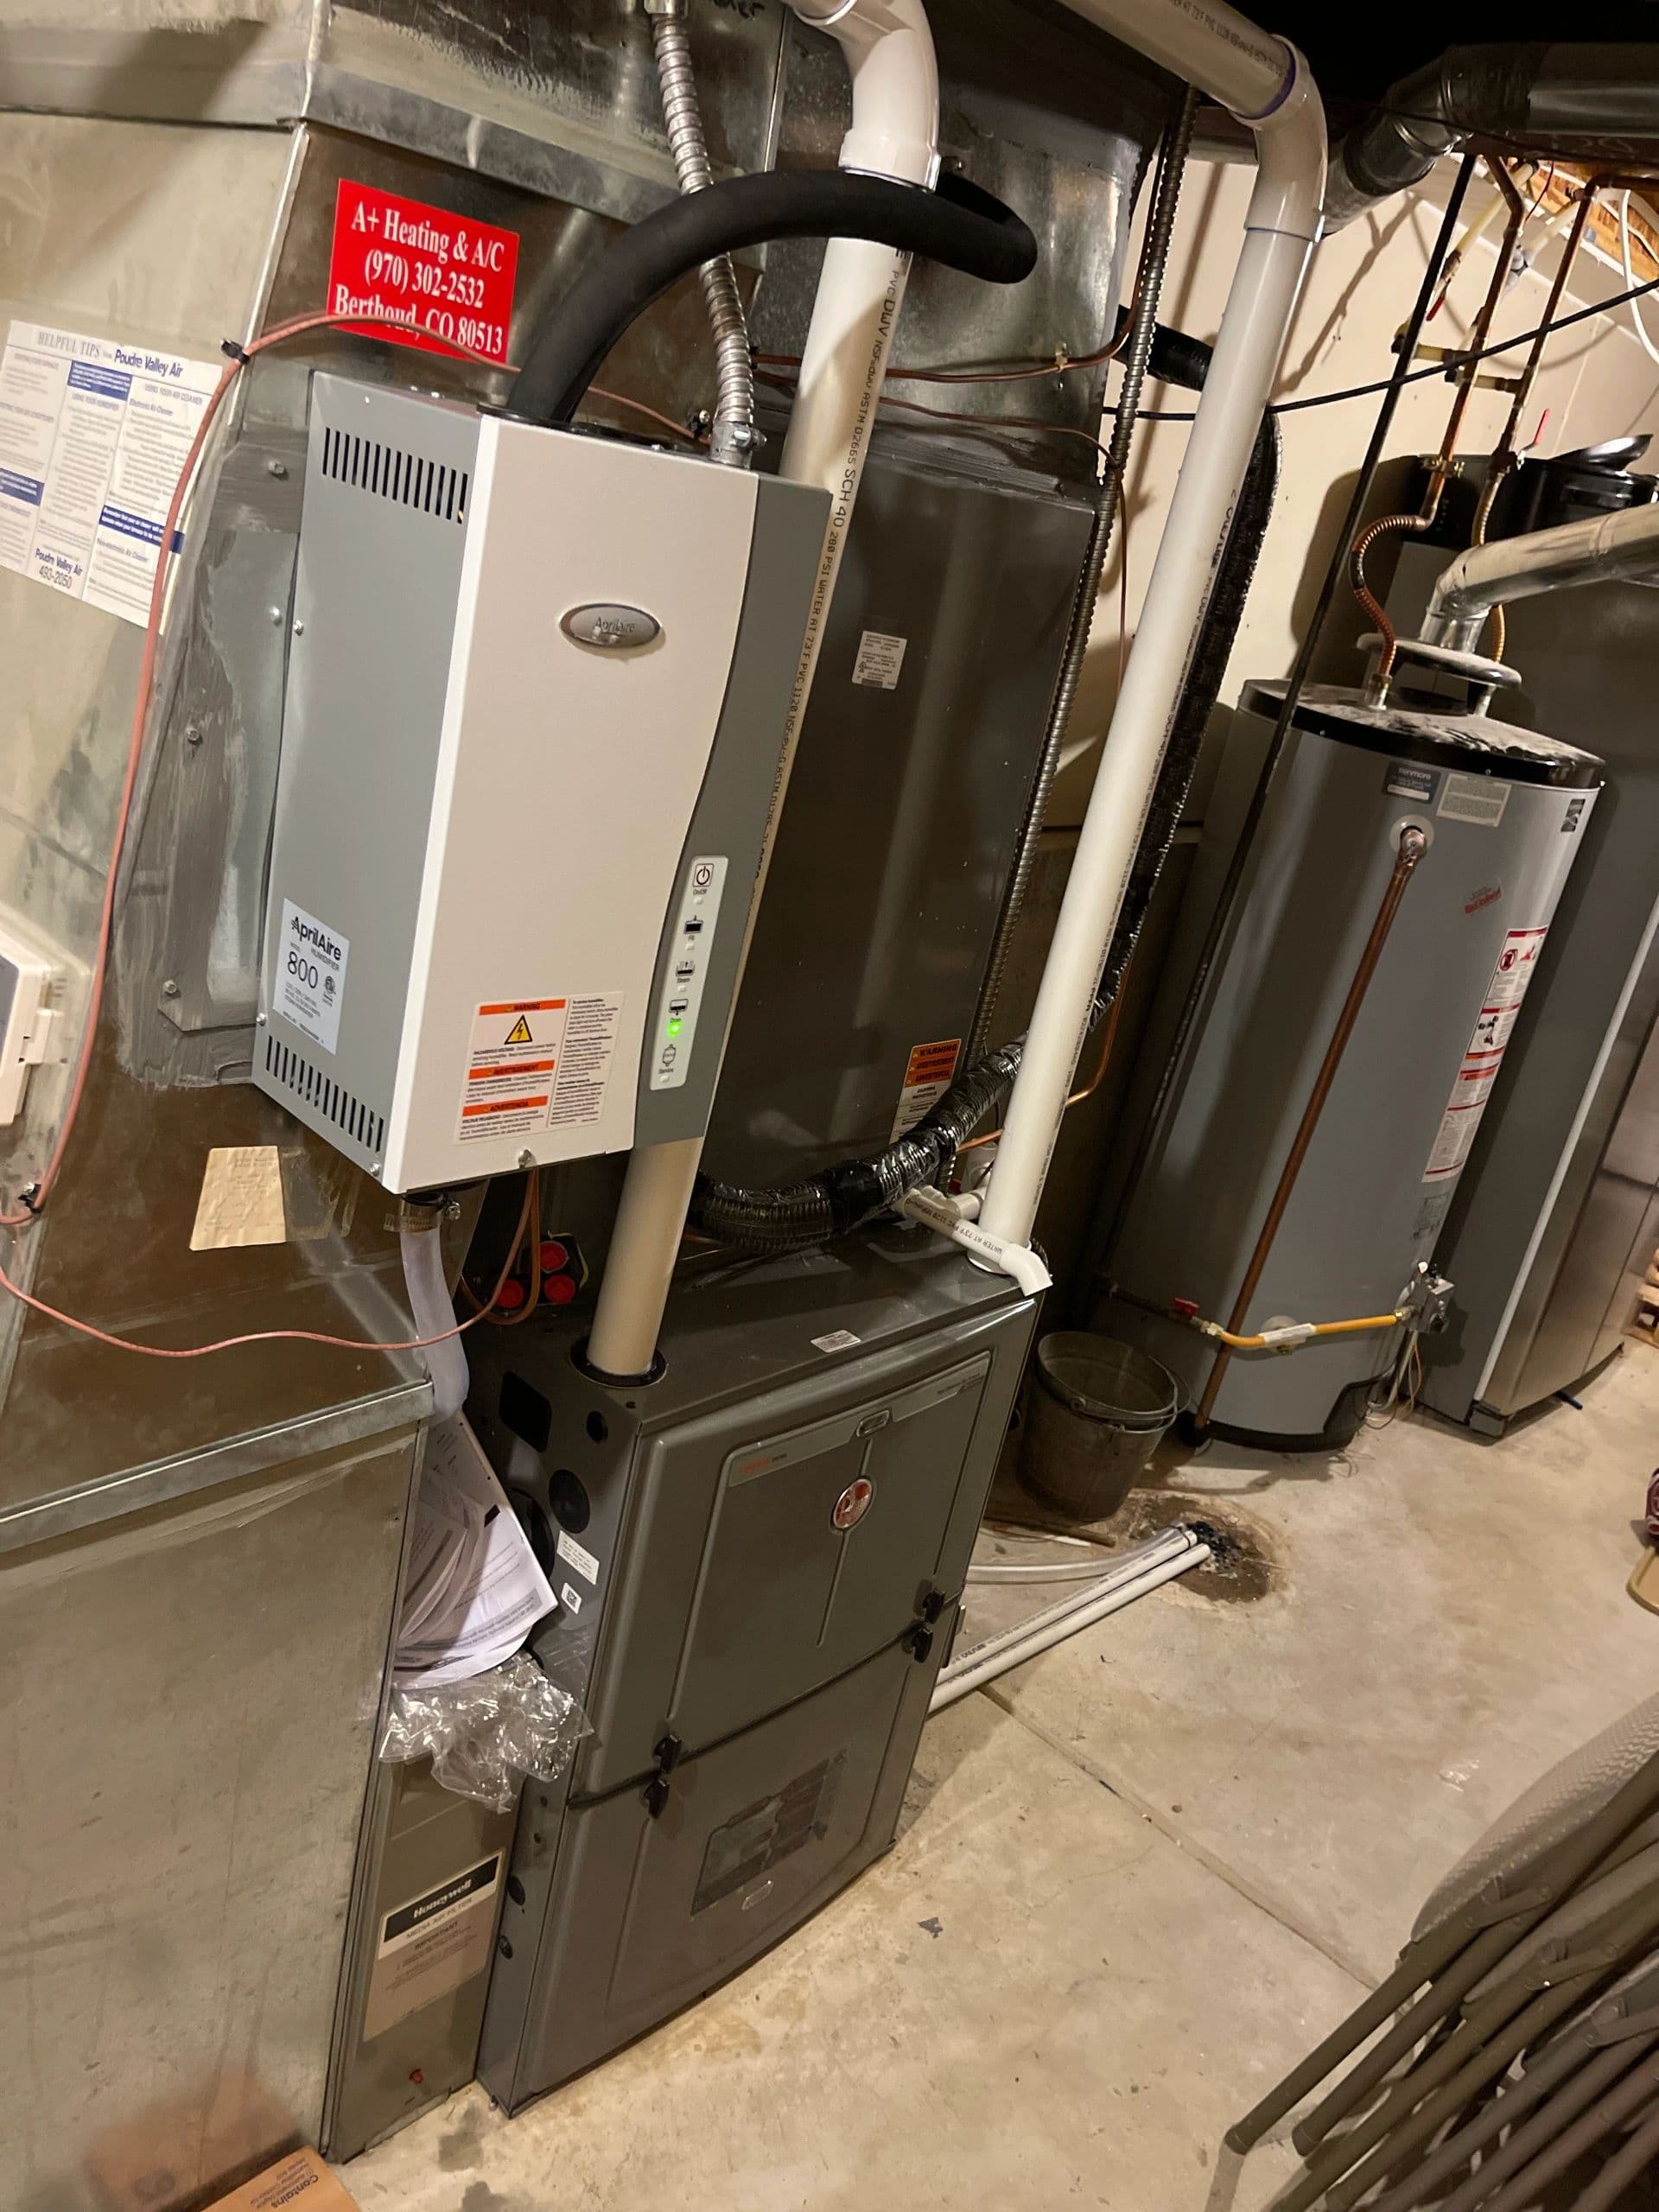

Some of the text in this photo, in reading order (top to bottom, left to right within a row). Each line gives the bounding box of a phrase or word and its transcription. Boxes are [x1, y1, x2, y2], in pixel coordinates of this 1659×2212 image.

[351, 201, 505, 272] A+ Heating & A/C
[365, 248, 485, 309] (970) 302-2532
[887, 270, 899, 296] PVC
[426, 308, 454, 340] CO
[457, 316, 503, 355] 80513
[878, 299, 896, 337] DWV
[80, 341, 100, 359] TIPS
[113, 349, 143, 369] Poudre
[144, 357, 169, 378] Valley
[169, 363, 184, 378] Air
[856, 392, 872, 423] ASTM
[847, 427, 863, 464] D2665
[839, 468, 856, 501] SCH
[833, 505, 847, 527] 40
[35, 547, 56, 564] Poudre
[56, 556, 73, 575] Valley
[821, 556, 834, 576] PSI
[812, 580, 827, 614] WATER
[808, 618, 819, 632] AT
[796, 663, 809, 683] PVC
[790, 687, 803, 712] 1120
[290, 916, 342, 962] AprilAire
[288, 950, 319, 989] 800
[513, 1002, 541, 1013] WARNING
[413, 1878, 472, 1918] Honeywell
[270, 2174, 319, 2209] Contains
